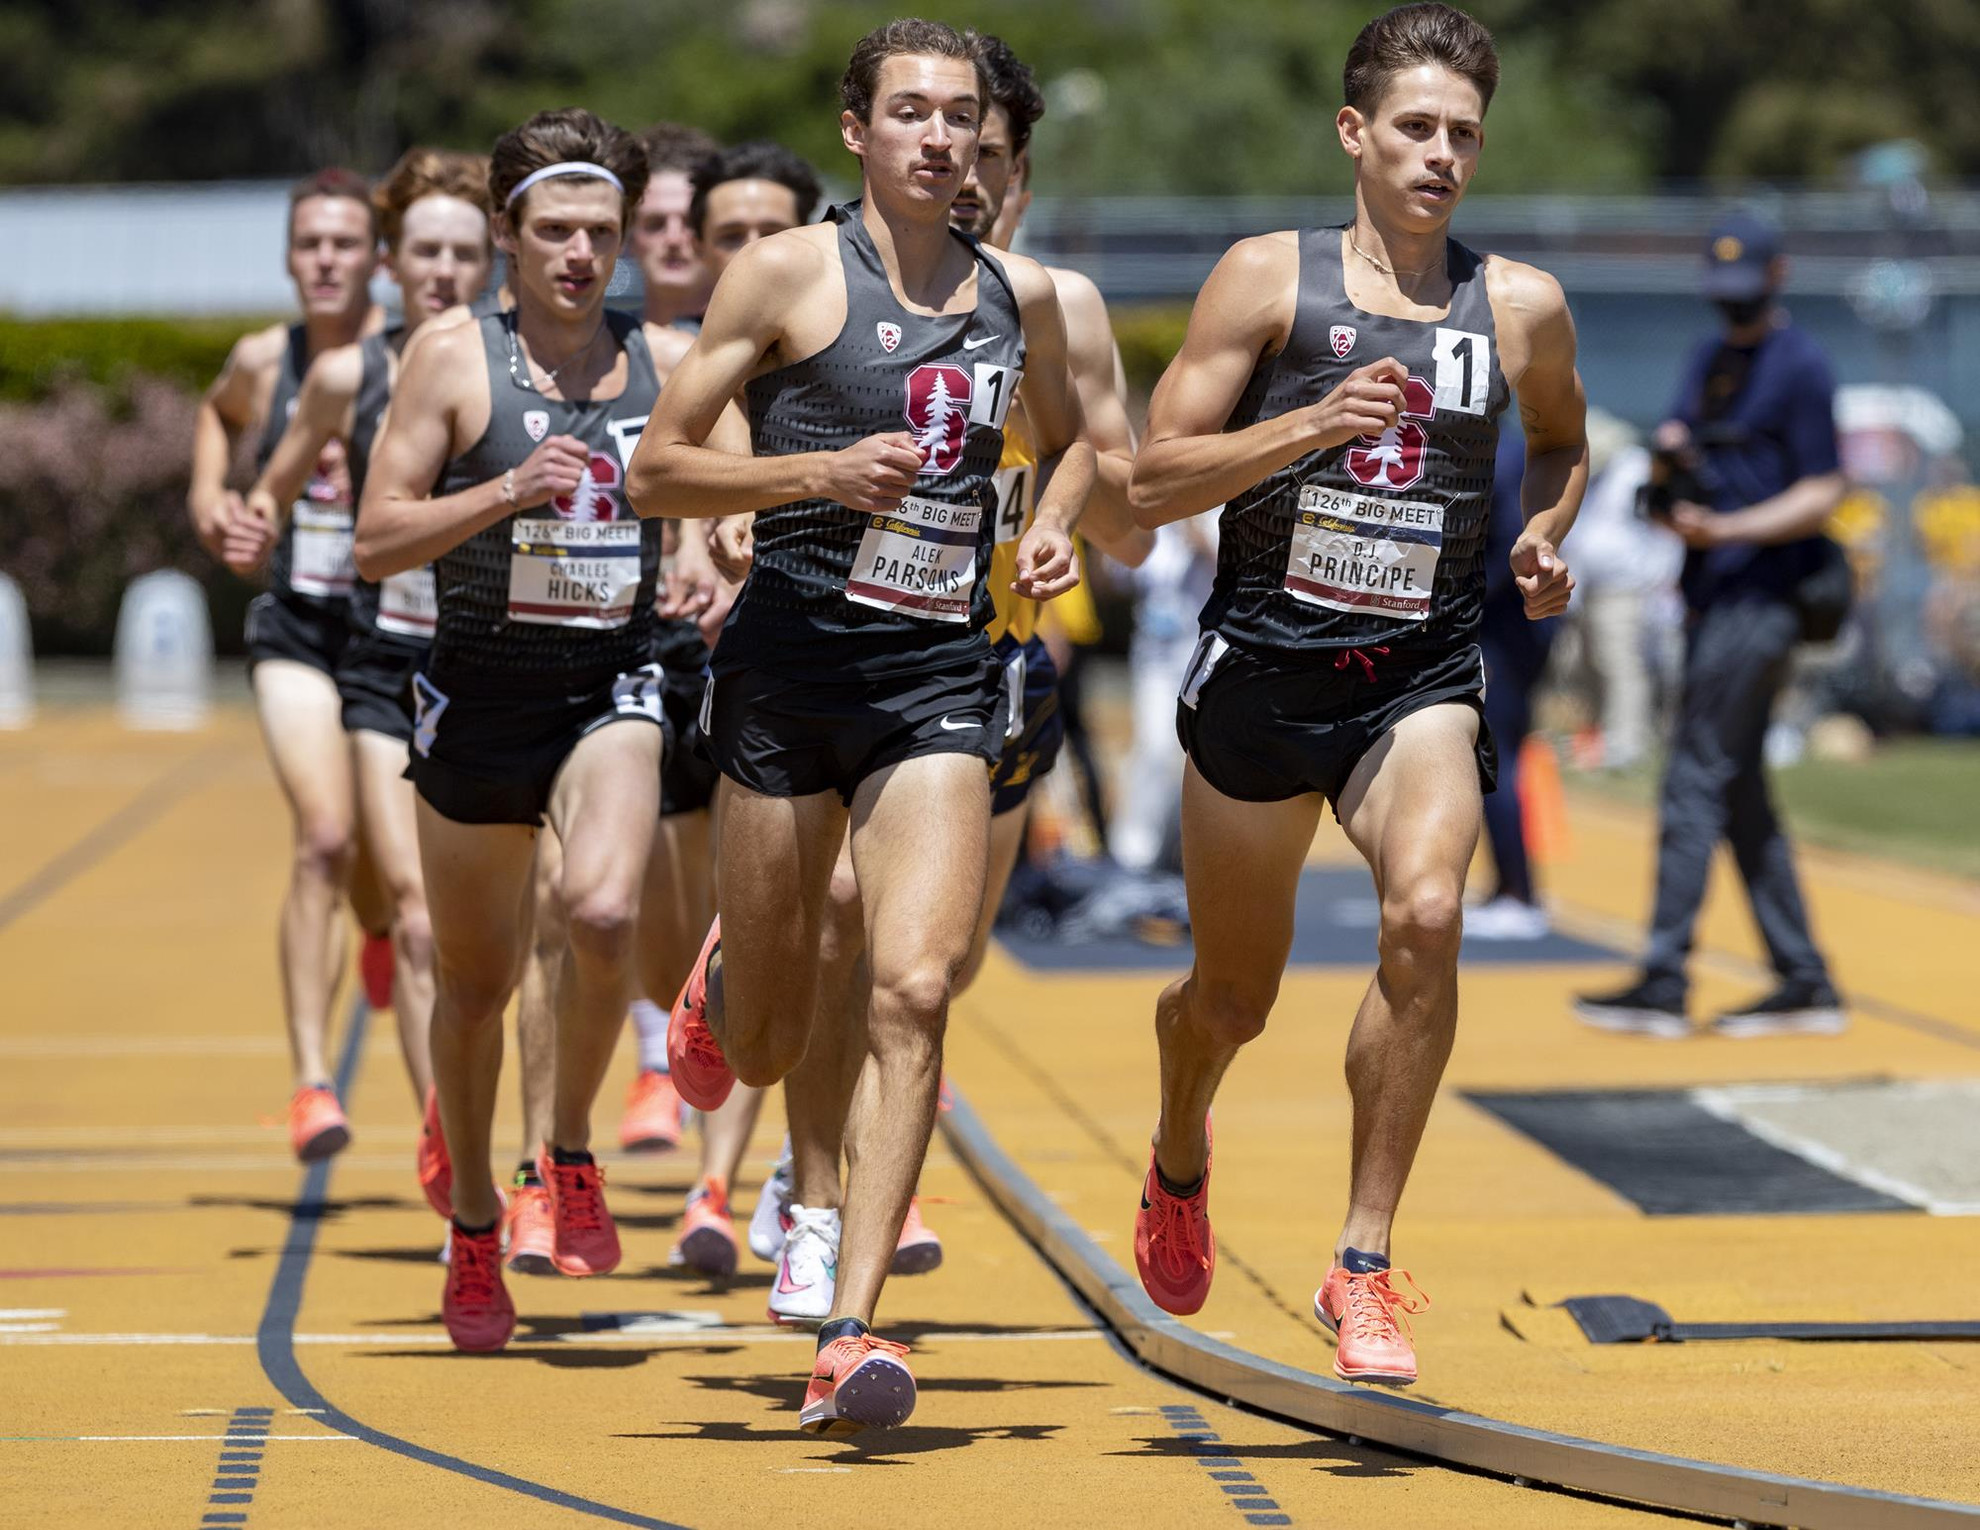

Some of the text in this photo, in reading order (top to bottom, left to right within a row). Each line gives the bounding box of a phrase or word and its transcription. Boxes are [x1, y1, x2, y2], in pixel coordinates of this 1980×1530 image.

[1335, 340, 1349, 351] 12
[1451, 337, 1472, 408] 1
[1002, 471, 1026, 536] 4
[1311, 491, 1435, 524] 126th BIG MEET
[922, 505, 947, 523] BIG
[950, 511, 977, 527] MEET
[565, 526, 591, 540] BIG
[596, 526, 632, 539] MEET
[911, 545, 943, 564] ALEK
[1354, 542, 1379, 560] D.J.
[550, 562, 609, 578] CHARLES
[872, 556, 959, 593] PARSONS
[1310, 552, 1416, 591] PRINCIPE
[548, 580, 610, 602] HICKS
[1382, 598, 1420, 609] Stanford
